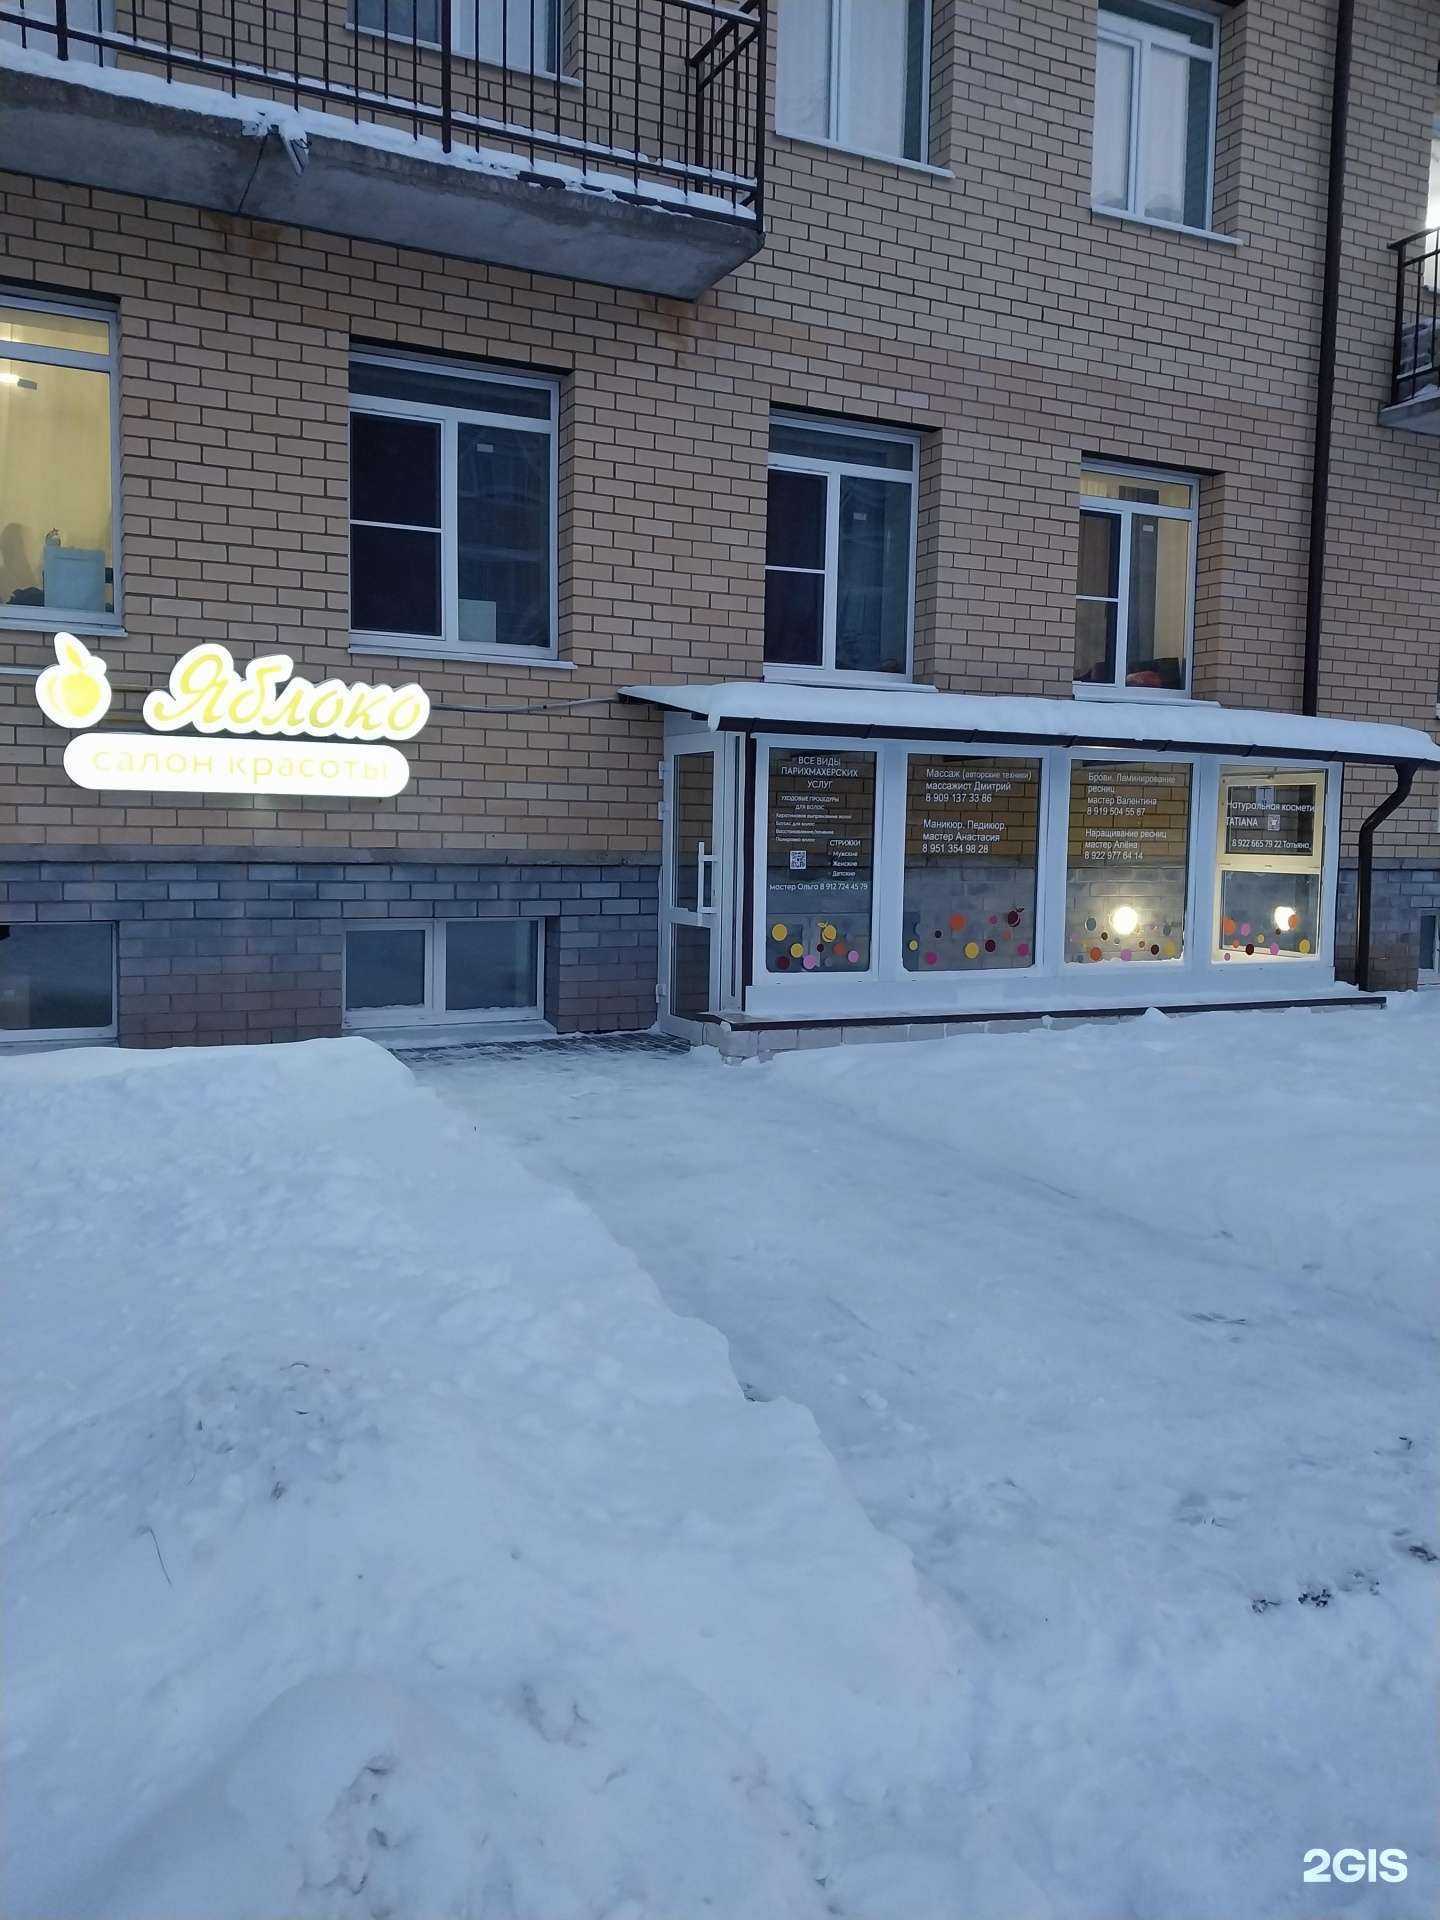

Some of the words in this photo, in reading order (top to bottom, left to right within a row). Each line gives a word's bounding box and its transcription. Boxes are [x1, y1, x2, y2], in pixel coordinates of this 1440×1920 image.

[153, 653, 420, 731] Яблоко
[798, 756, 815, 765] ВСЕ
[817, 757, 841, 766] ВИДЫ
[91, 751, 215, 774] салон
[228, 753, 389, 784] красоты
[781, 766, 858, 777] ПАРИХМАХЕРСКИХ
[926, 769, 960, 778] Массаж
[807, 780, 833, 789] УСЛУГ
[925, 782, 971, 791] массажист
[974, 781, 1011, 792] Дмитрий
[1088, 785, 1115, 793] ресниц
[925, 793, 931, 802] 8
[934, 793, 949, 802] 909
[952, 793, 966, 803] 137
[968, 794, 980, 803] 33
[981, 794, 992, 803] 86
[1087, 797, 1115, 806] мастер
[1116, 796, 1157, 806] Валентина
[1093, 807, 1108, 815] 919
[1281, 804, 1317, 812] космети
[1225, 816, 1258, 827] TATIANA
[922, 833, 953, 842] мастер
[955, 832, 1000, 841] Анастасия
[1085, 829, 1138, 840] Наращивание
[922, 844, 928, 852] 8
[930, 844, 944, 853] 951
[948, 844, 963, 853] 354
[965, 844, 976, 853] 98
[978, 844, 989, 853] 28
[1084, 841, 1112, 850] мастер
[1232, 839, 1237, 848] 8
[1237, 839, 1250, 848] 922
[1091, 851, 1106, 860] 922
